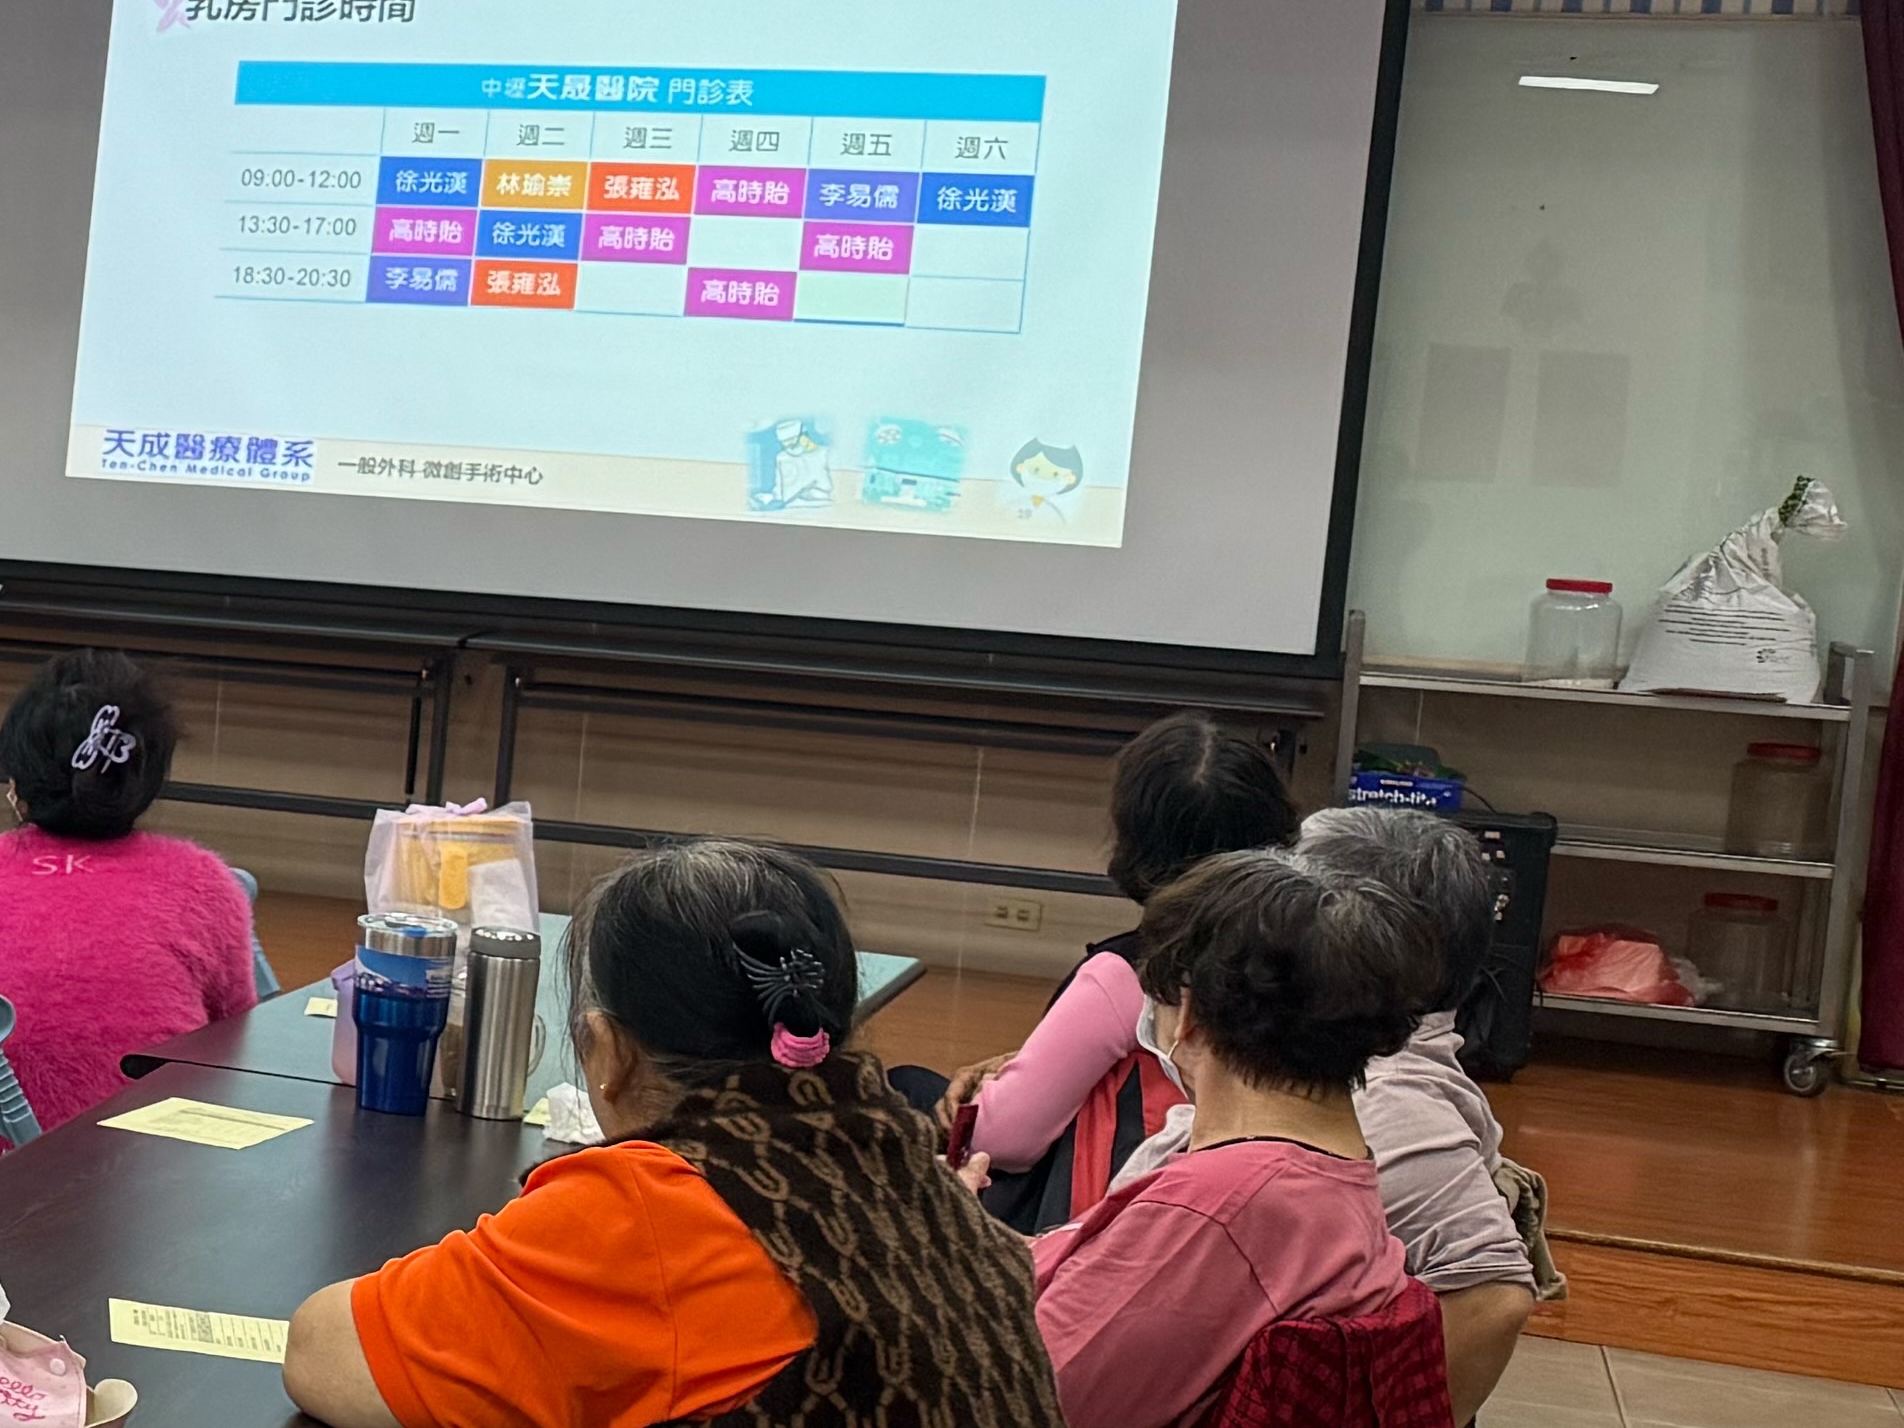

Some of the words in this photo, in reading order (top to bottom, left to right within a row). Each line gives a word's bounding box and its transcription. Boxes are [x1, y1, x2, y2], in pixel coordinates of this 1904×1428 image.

[667, 78, 755, 107] 門診表
[411, 121, 460, 144] 週一
[516, 124, 566, 147] 週二
[623, 126, 674, 150] 週三
[728, 129, 780, 153] 週四
[841, 132, 893, 157] 週五
[954, 136, 1008, 160] 週六
[241, 168, 362, 190] 09:00-12:00
[395, 169, 468, 195] 徐光漢
[936, 186, 1017, 214] 徐光漢
[238, 215, 357, 237] 13:30-17:00
[491, 222, 566, 248] 徐光漢
[233, 265, 352, 288] 18:30-20:30
[103, 429, 315, 469] 天成醫療體系
[186, 462, 252, 478] Medical
[259, 470, 311, 484] Group
